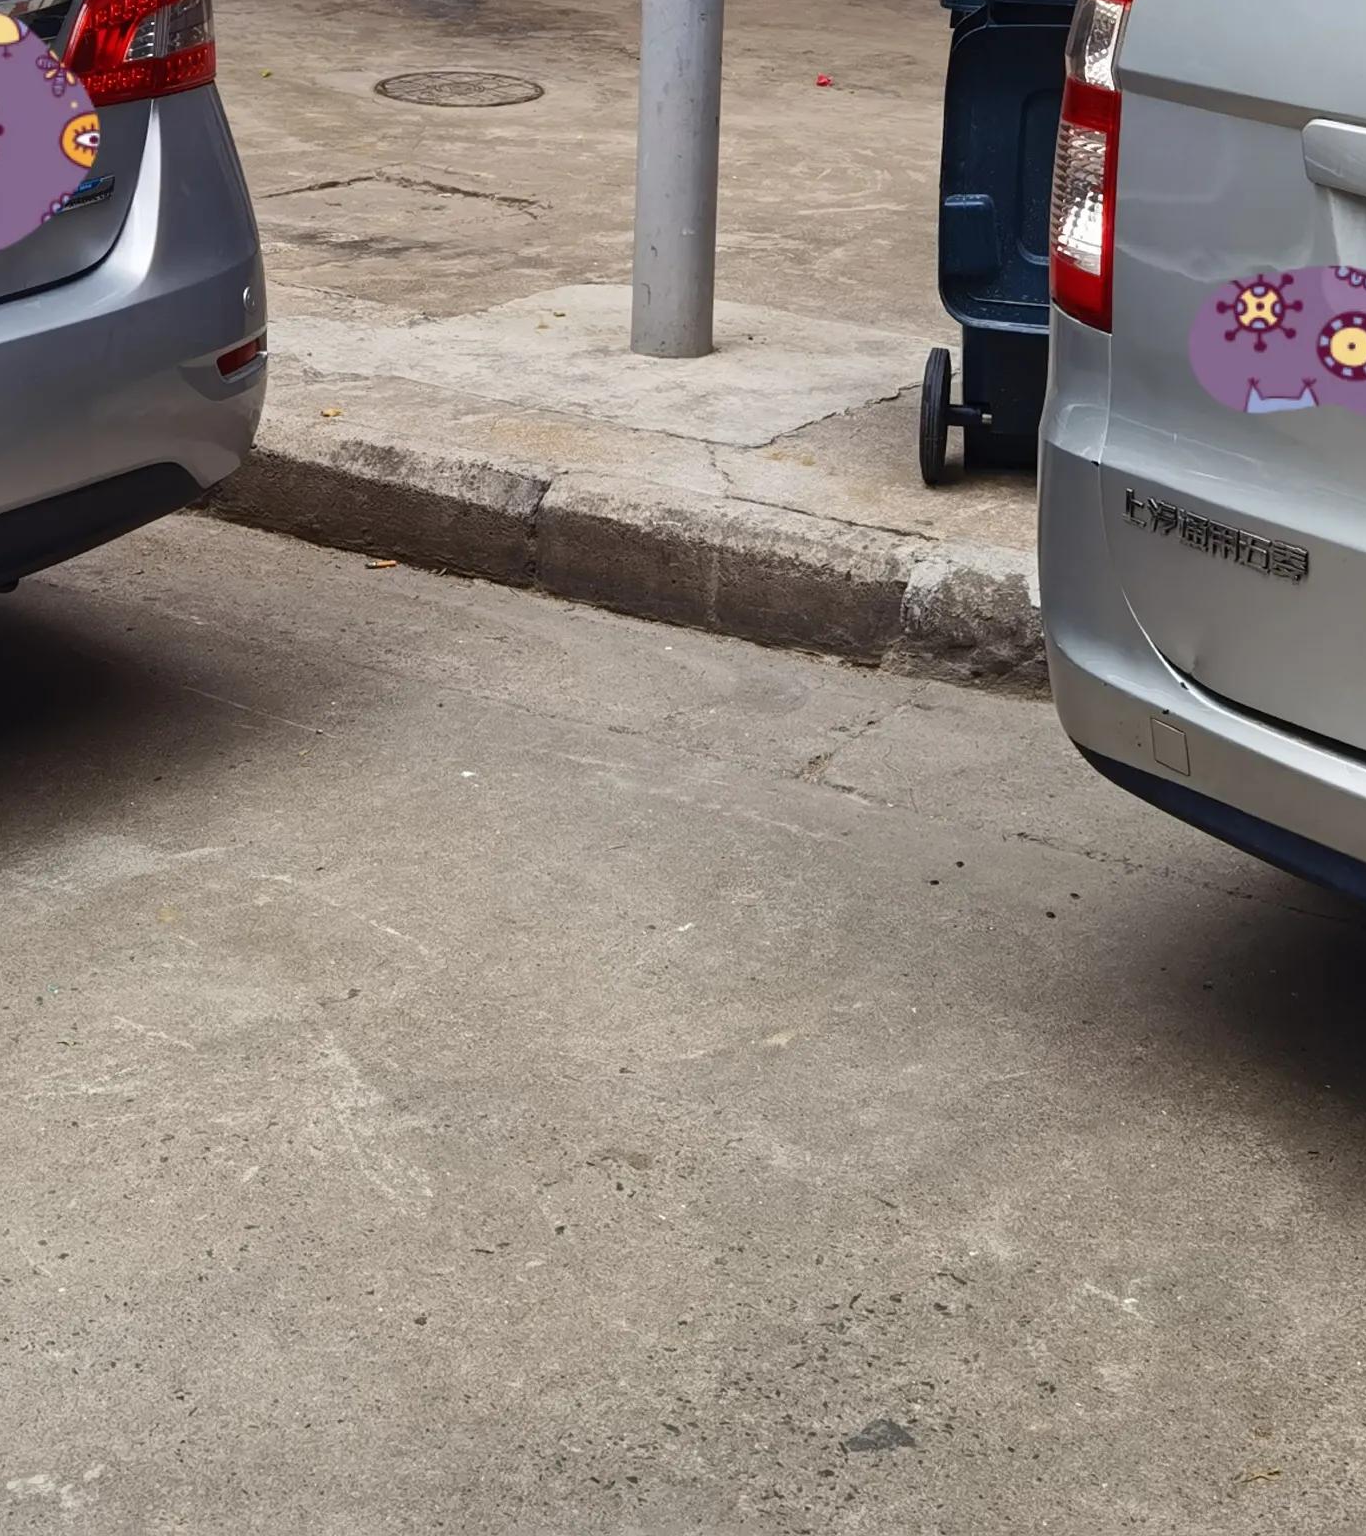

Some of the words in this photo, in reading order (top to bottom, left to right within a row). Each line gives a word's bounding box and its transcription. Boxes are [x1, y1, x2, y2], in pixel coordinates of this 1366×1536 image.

[1123, 487, 1309, 585] 上汽通用五菱
